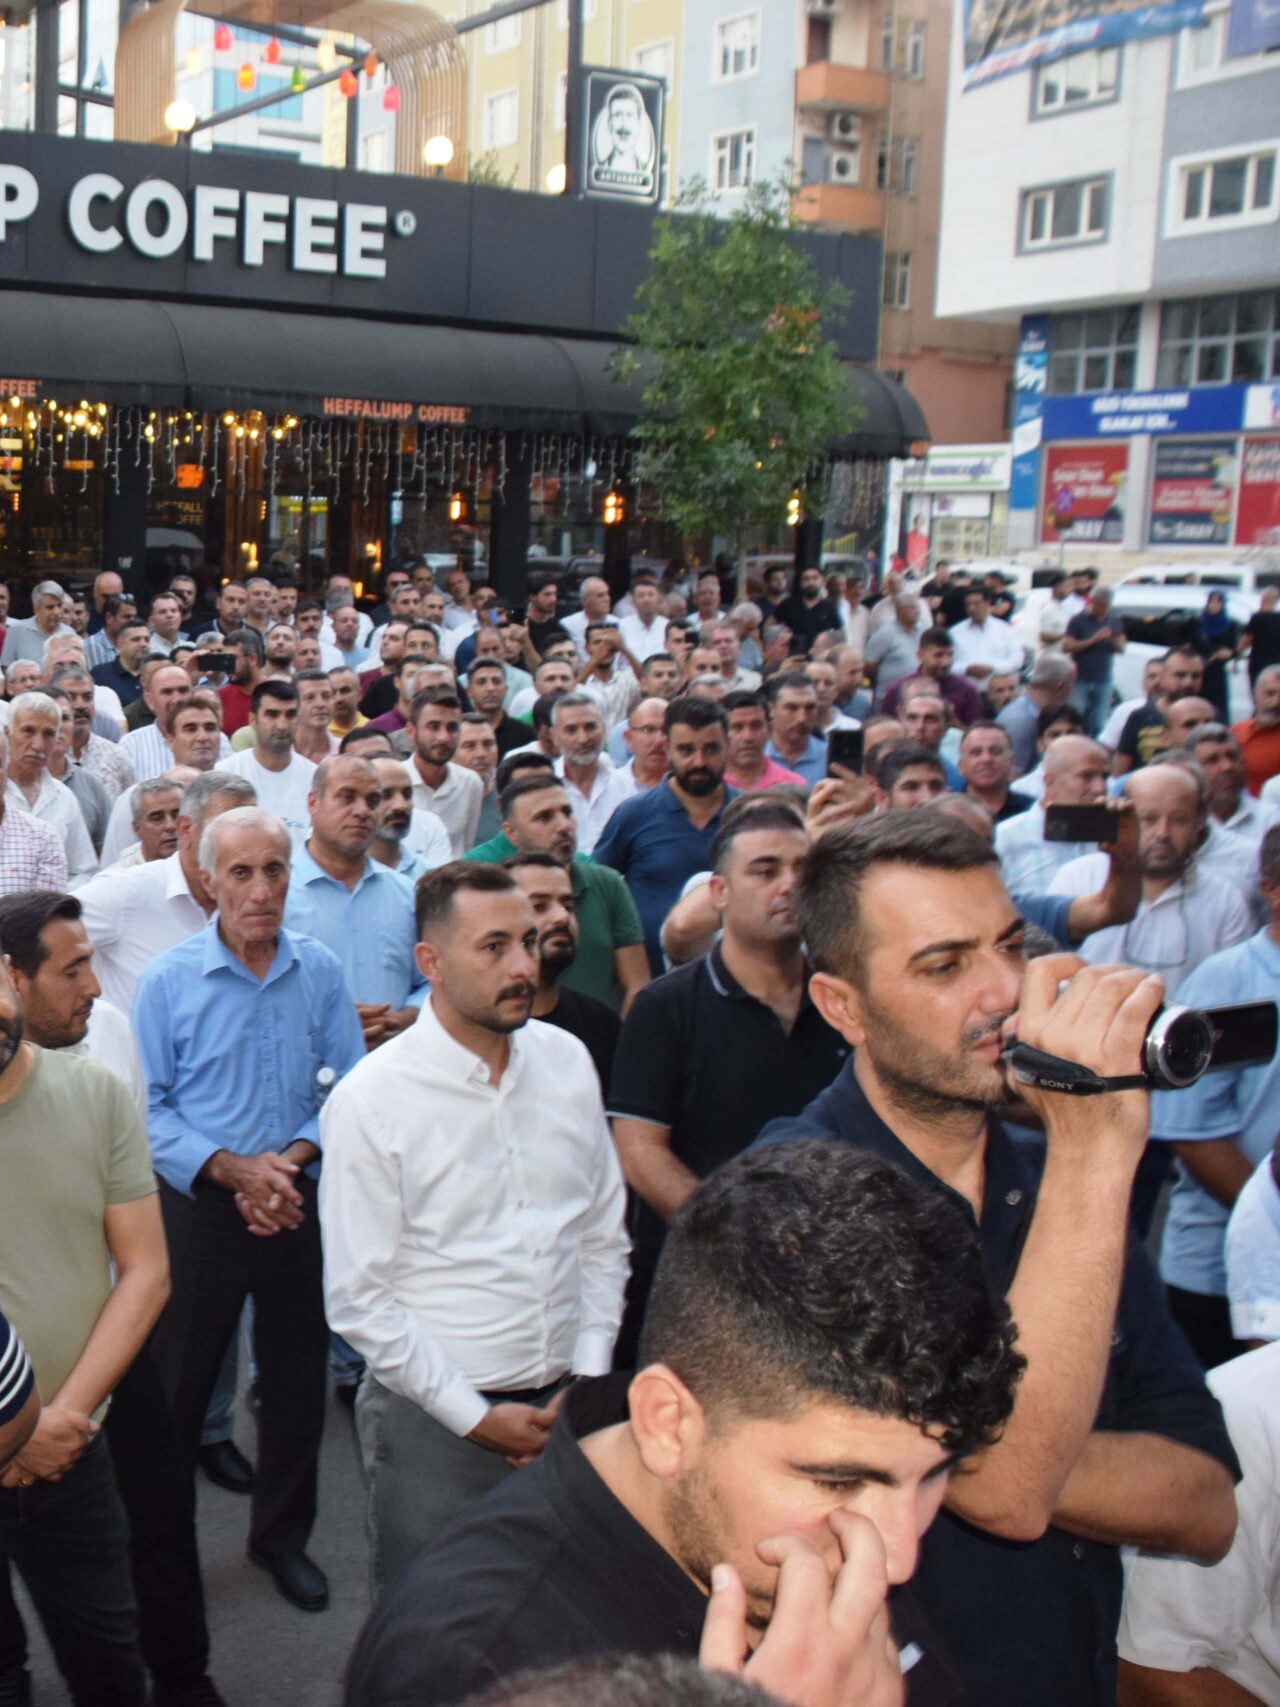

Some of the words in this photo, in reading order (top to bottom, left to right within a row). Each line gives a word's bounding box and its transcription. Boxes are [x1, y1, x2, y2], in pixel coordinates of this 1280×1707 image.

[323, 396, 413, 420] HEFFALUMP
[418, 404, 467, 424] COFFEE
[1039, 1078, 1075, 1091] SONY
